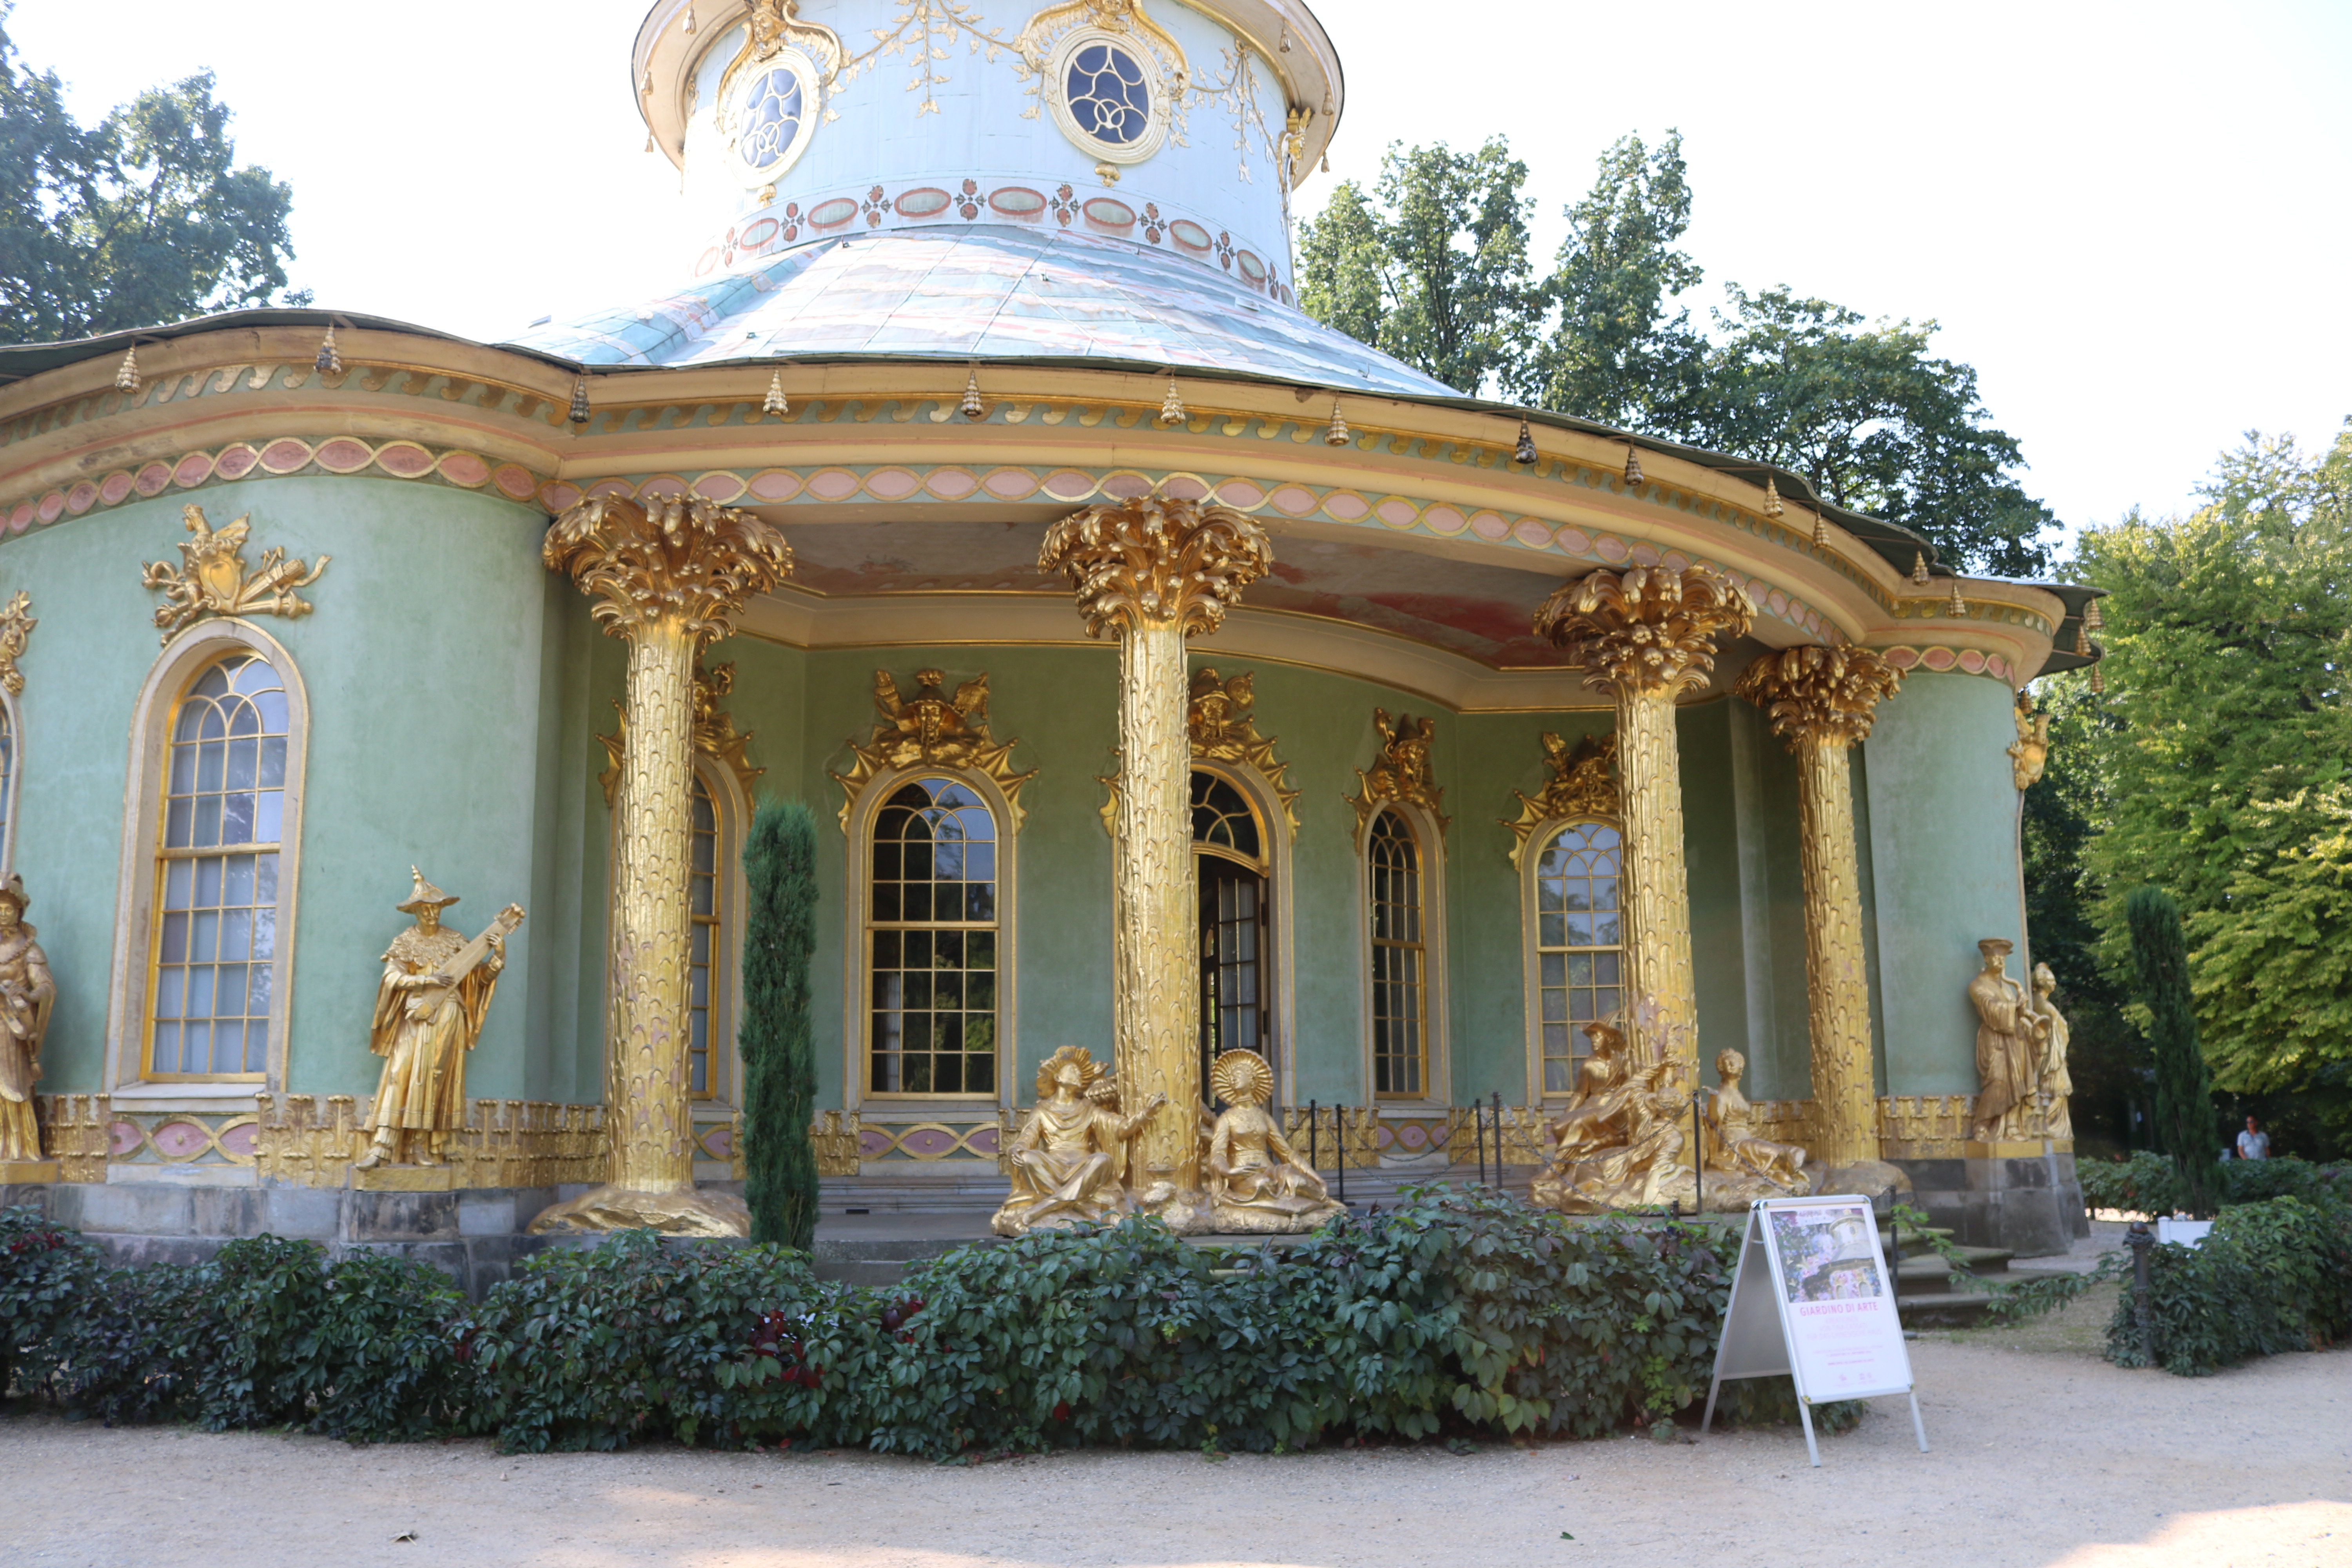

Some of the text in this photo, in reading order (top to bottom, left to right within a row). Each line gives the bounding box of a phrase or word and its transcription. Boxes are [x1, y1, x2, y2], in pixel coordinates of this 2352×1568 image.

[1800, 1302, 1879, 1316] GIARDINO DI ARTE
